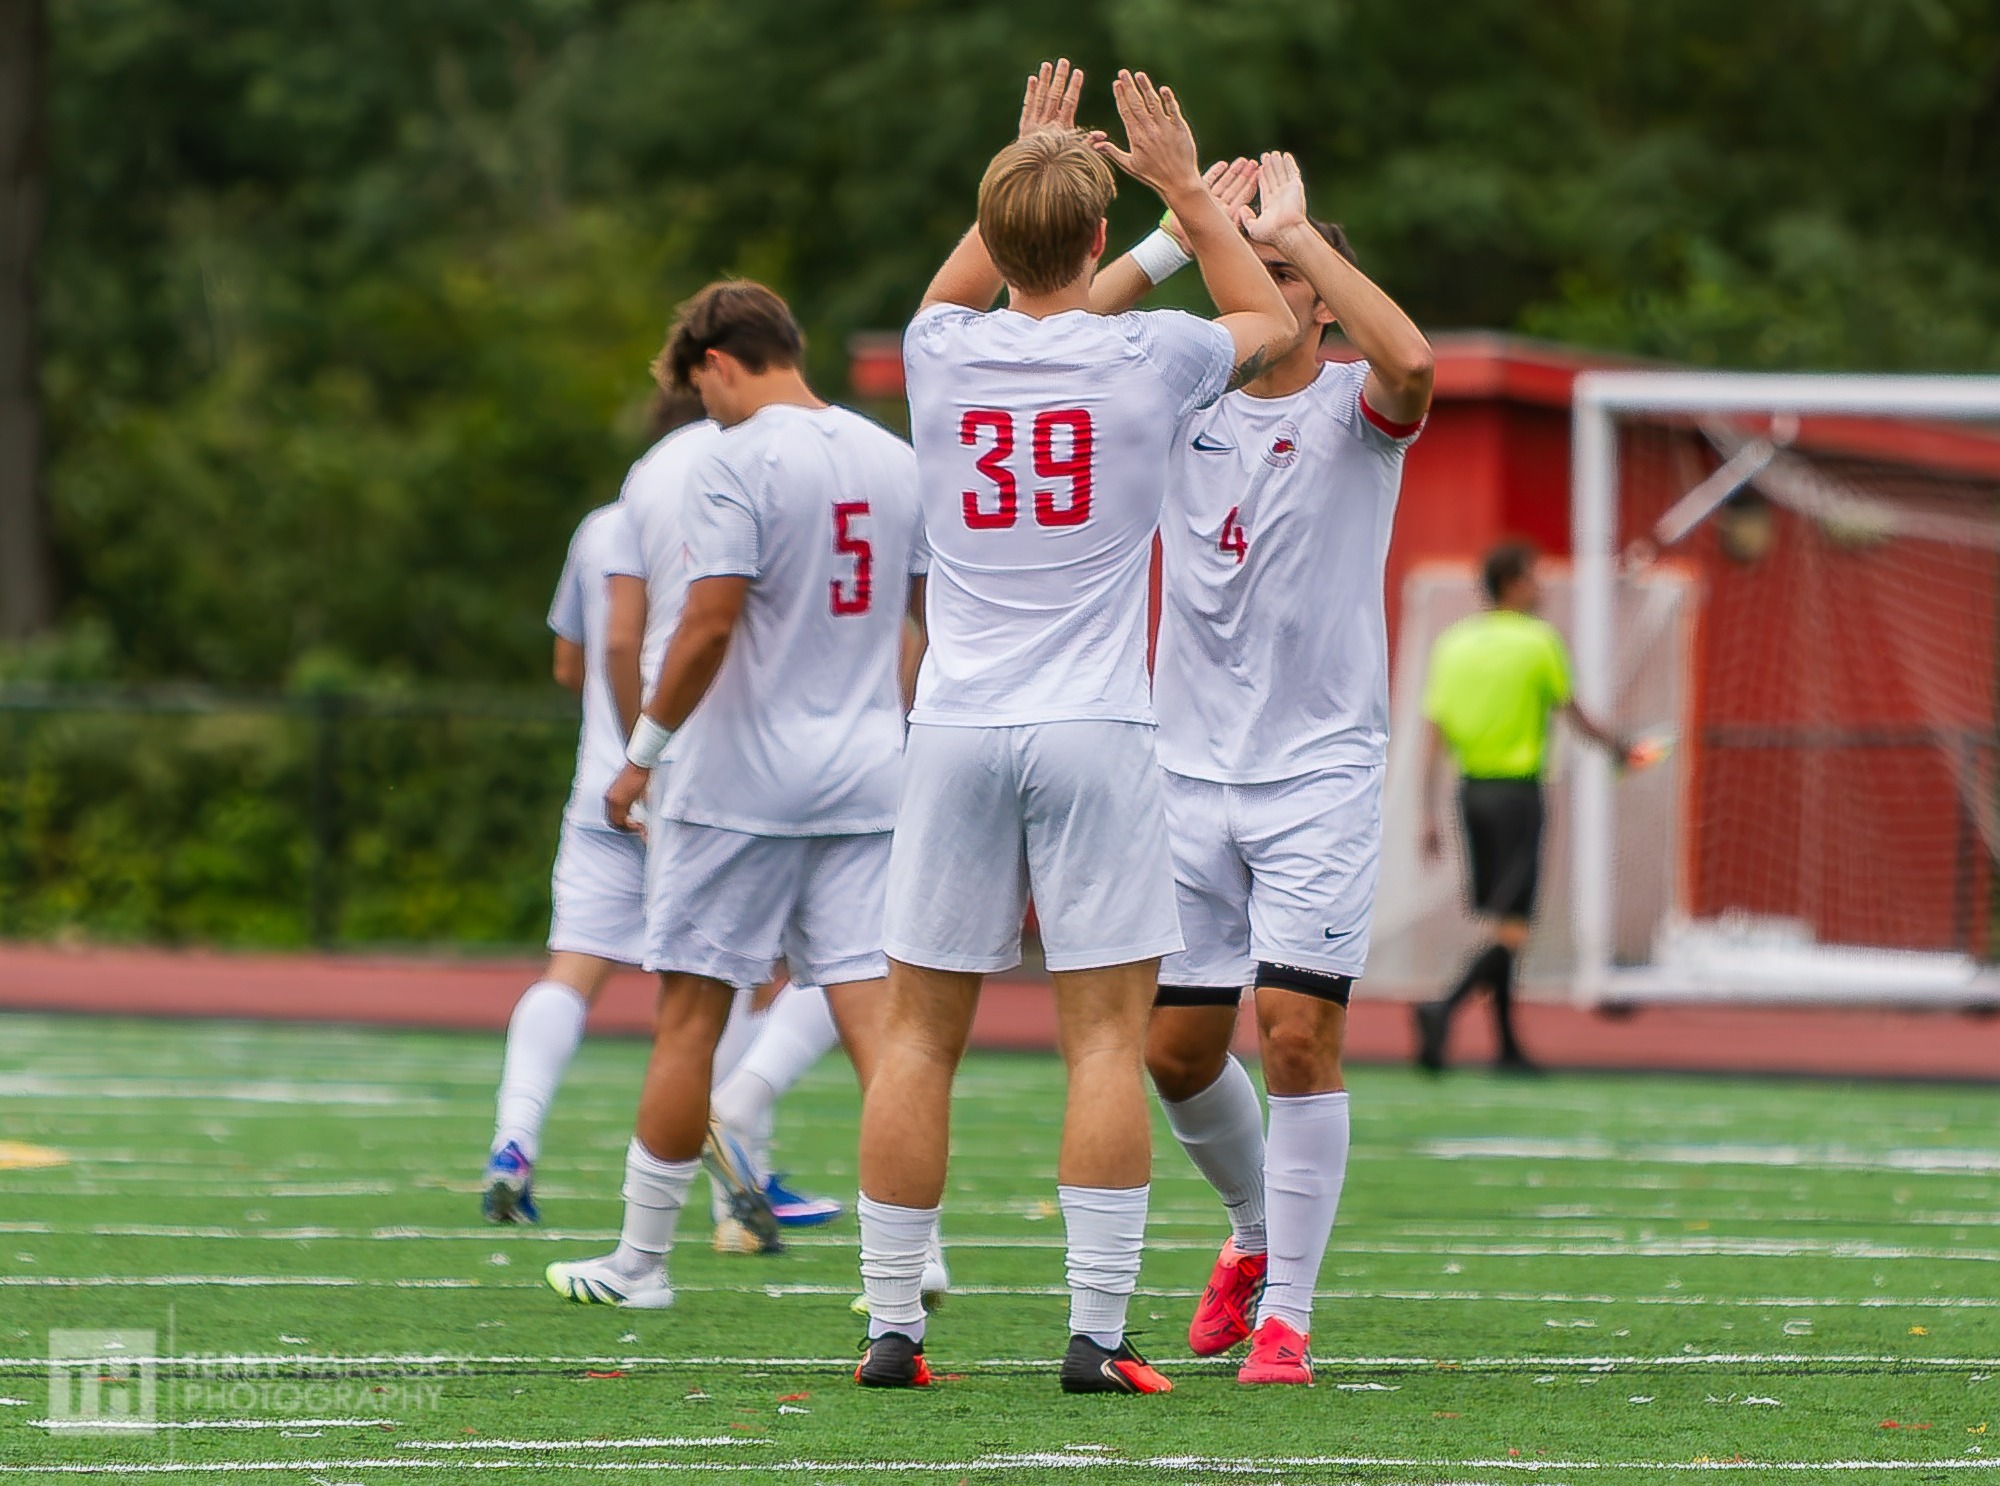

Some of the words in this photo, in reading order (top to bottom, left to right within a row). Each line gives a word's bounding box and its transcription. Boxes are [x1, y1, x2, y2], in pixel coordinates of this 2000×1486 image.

[960, 408, 1093, 530] 39
[831, 501, 872, 615] 5
[1218, 507, 1248, 562] 4
